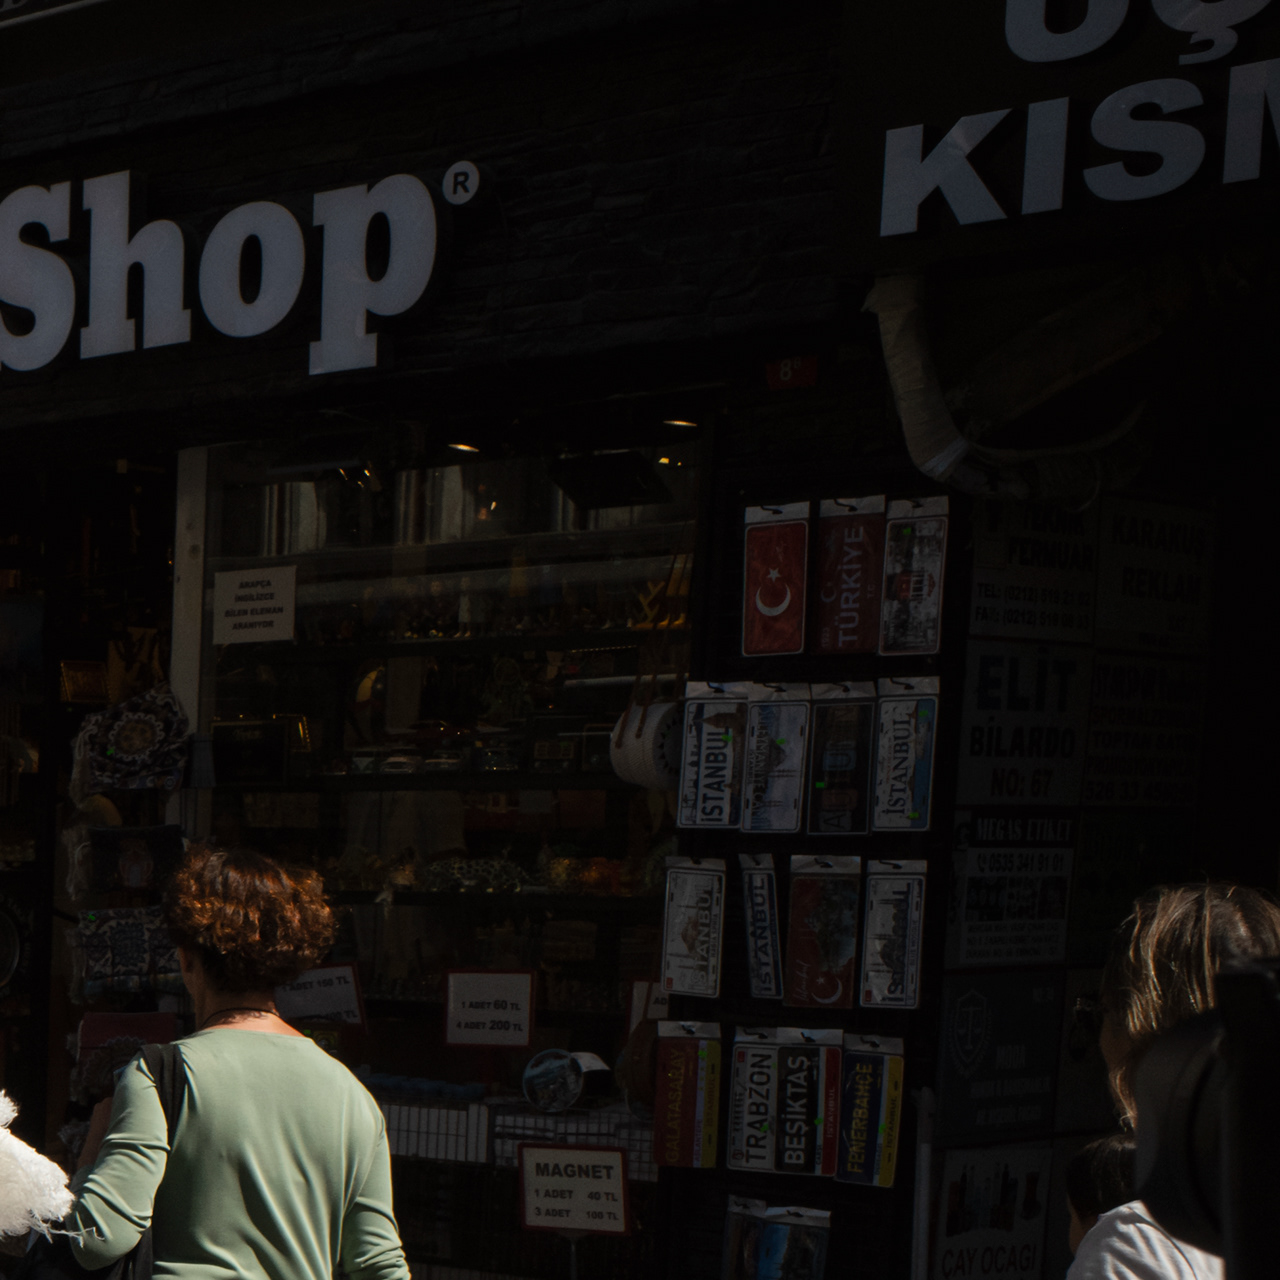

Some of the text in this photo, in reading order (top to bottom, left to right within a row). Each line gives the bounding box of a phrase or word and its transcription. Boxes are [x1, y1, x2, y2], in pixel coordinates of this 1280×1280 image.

[238, 580, 272, 589] ARAPÇA
[834, 526, 865, 648] TÜRKİYE
[1121, 565, 1201, 604] REKLAM
[250, 606, 283, 616] ELEMAN
[977, 648, 1077, 713] ELİT
[970, 716, 1075, 759] BİLARDO
[700, 727, 730, 822] İSTANBUL
[883, 717, 912, 815] İSTANBUL
[991, 768, 1053, 797] NO: 67
[989, 853, 1014, 872] 0535
[336, 976, 350, 985] TL
[344, 1010, 358, 1019] TL
[469, 1001, 492, 1010] ADET
[493, 1000, 508, 1010] 60
[510, 1002, 521, 1011] TL
[464, 1021, 487, 1030] ADET
[489, 1020, 510, 1031] 200
[512, 1023, 523, 1032] TL
[666, 1048, 686, 1163] GALATASARAY
[745, 1053, 772, 1163] TRABZON
[781, 1055, 811, 1166] BEŞİKTAŞ
[847, 1062, 873, 1174] FENERBAHÇE
[535, 1162, 614, 1181] MAGNET
[544, 1189, 573, 1200] ADET
[587, 1190, 601, 1201] 40
[604, 1191, 618, 1202] TL
[535, 1207, 619, 1222] 3 ADET 100 TL
